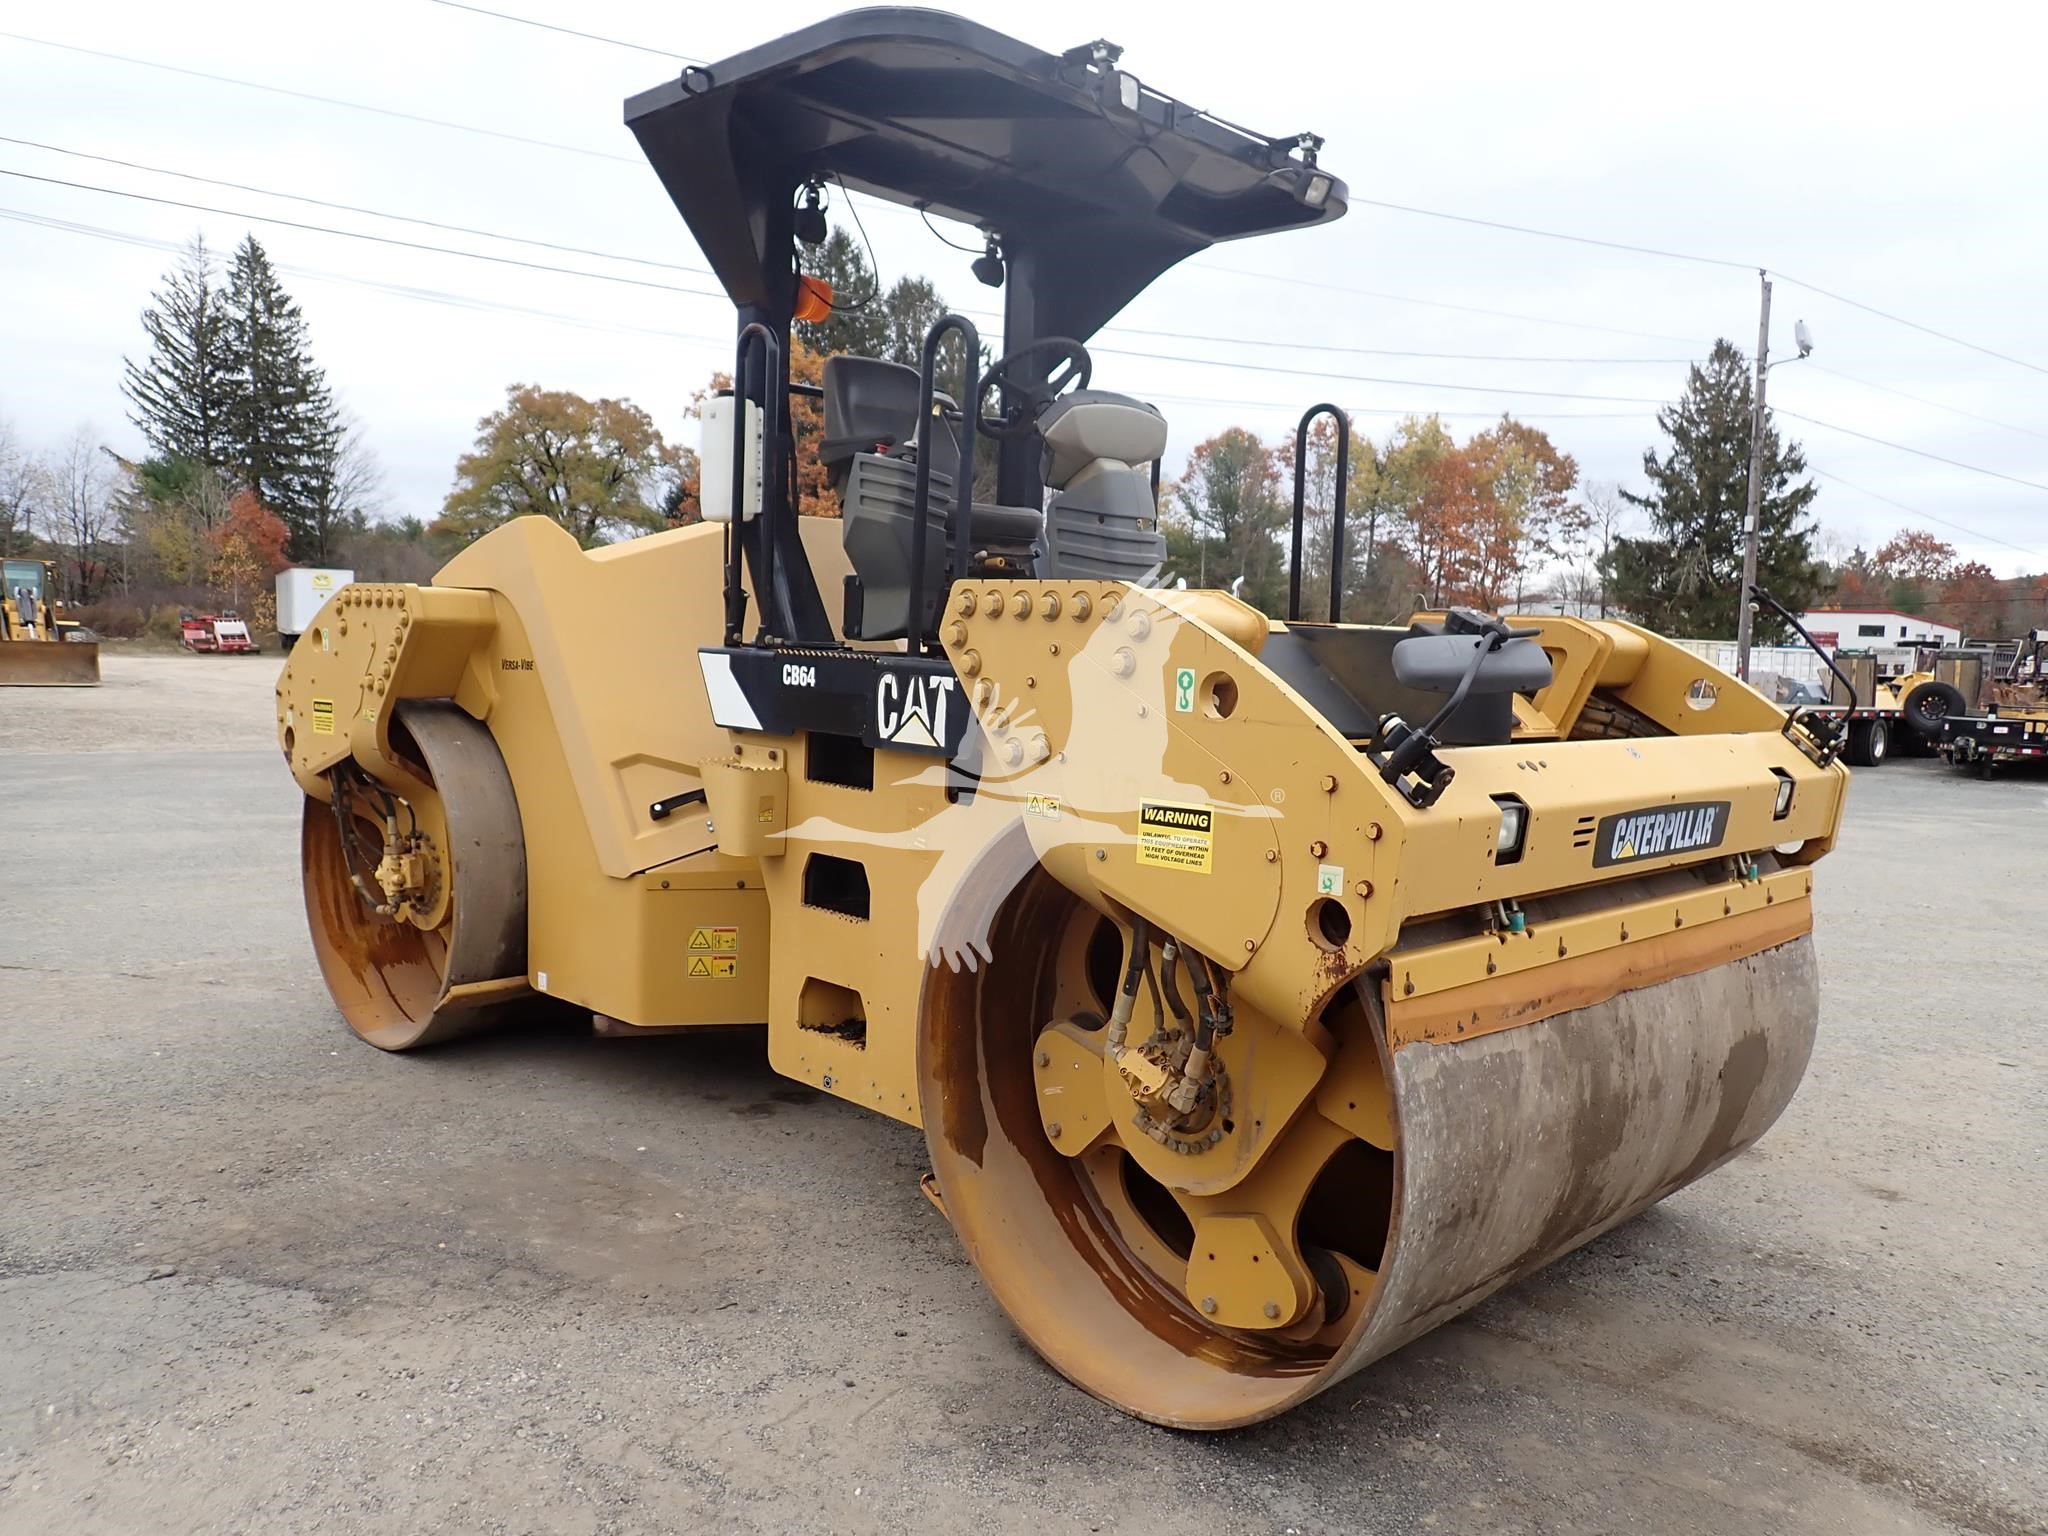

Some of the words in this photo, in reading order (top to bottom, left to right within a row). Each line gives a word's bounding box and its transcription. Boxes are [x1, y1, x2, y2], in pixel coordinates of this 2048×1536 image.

[782, 664, 816, 687] CB64
[877, 673, 955, 748] CAT
[1144, 807, 1209, 828] WARNING
[1142, 831, 1172, 841] UNLAWFUL
[1182, 836, 1208, 845] OPERATE
[1611, 806, 1717, 859] CATERPILLAR
[1151, 846, 1165, 854] FEET
[1174, 850, 1205, 859] OVERHEAD
[1154, 840, 1187, 849] EQUIPMENT
[1187, 845, 1209, 853] WITHIN
[1145, 852, 1159, 860] HIGH
[1160, 855, 1185, 864] VOLTAGE
